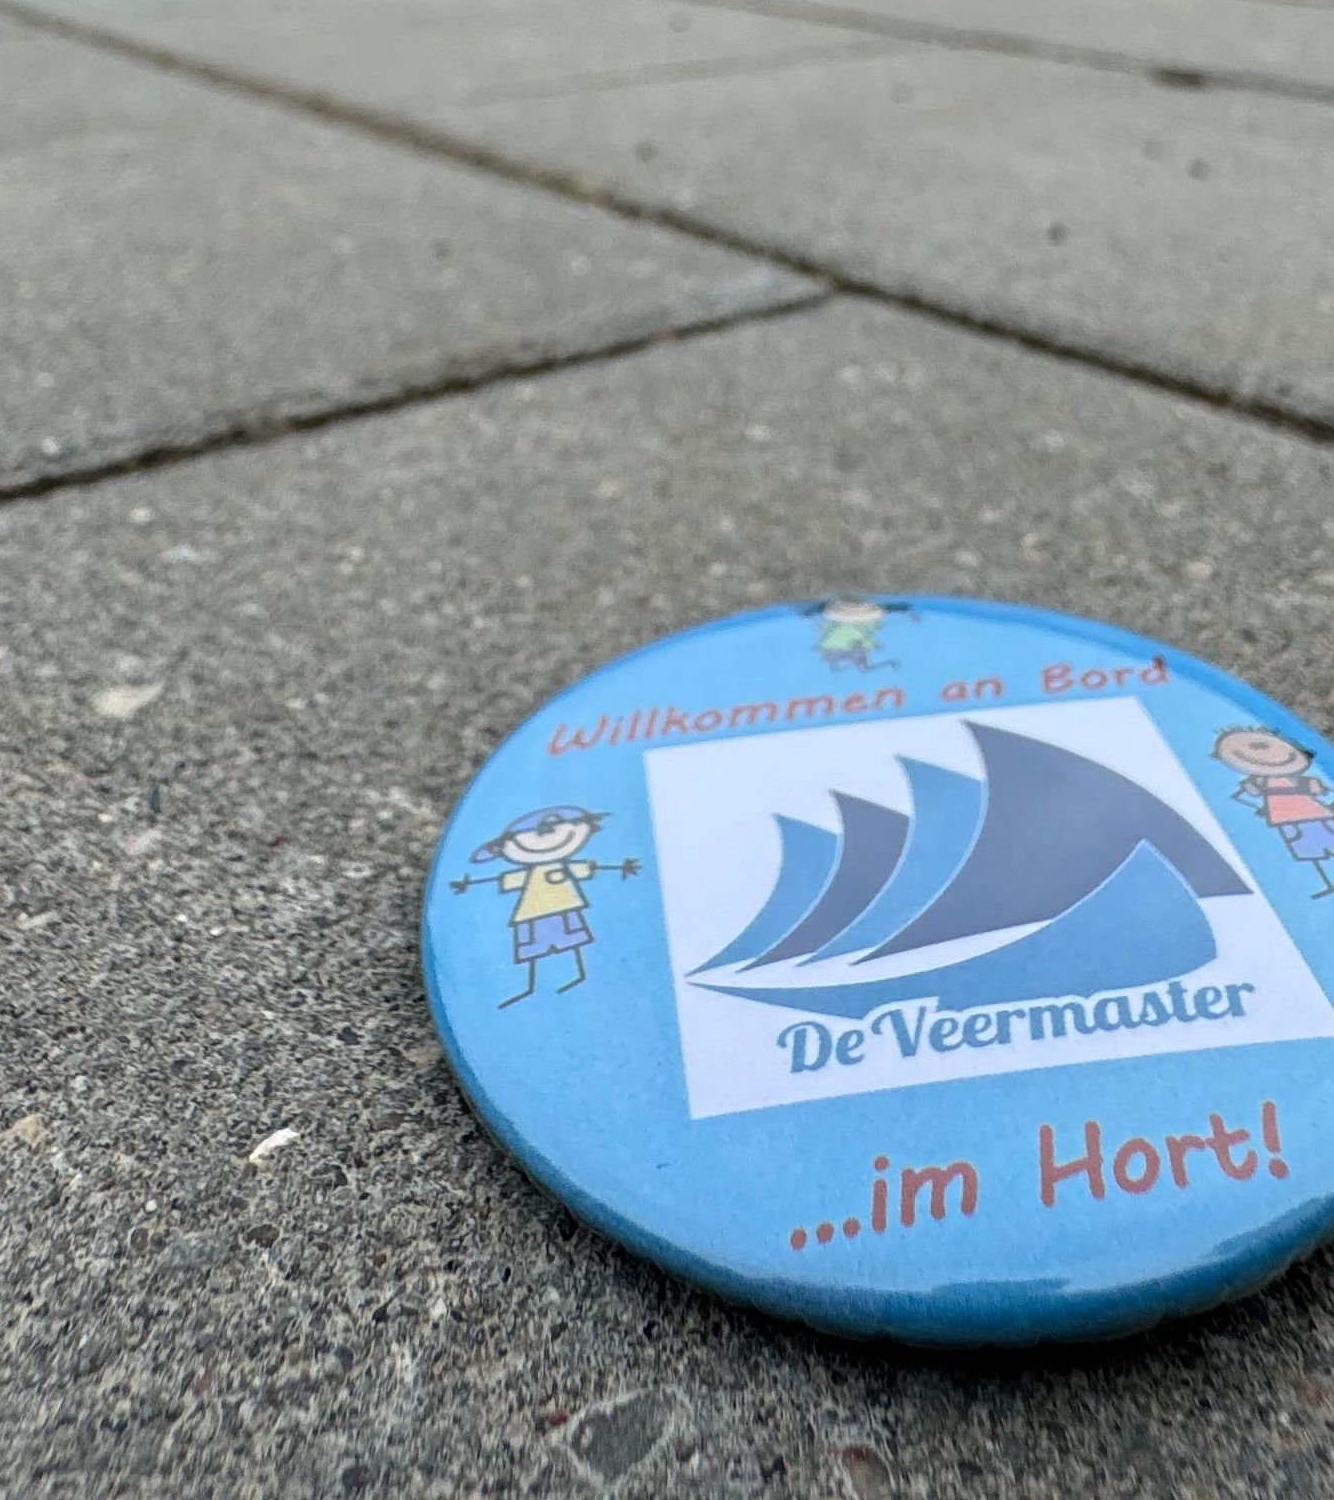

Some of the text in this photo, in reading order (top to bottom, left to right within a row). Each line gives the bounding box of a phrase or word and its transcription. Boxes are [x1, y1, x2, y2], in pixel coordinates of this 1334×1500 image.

[546, 655, 1169, 756] Willkommen an Bord
[776, 978, 1257, 1074] De Veermaster
[788, 1101, 1289, 1250] ...im Hort!
